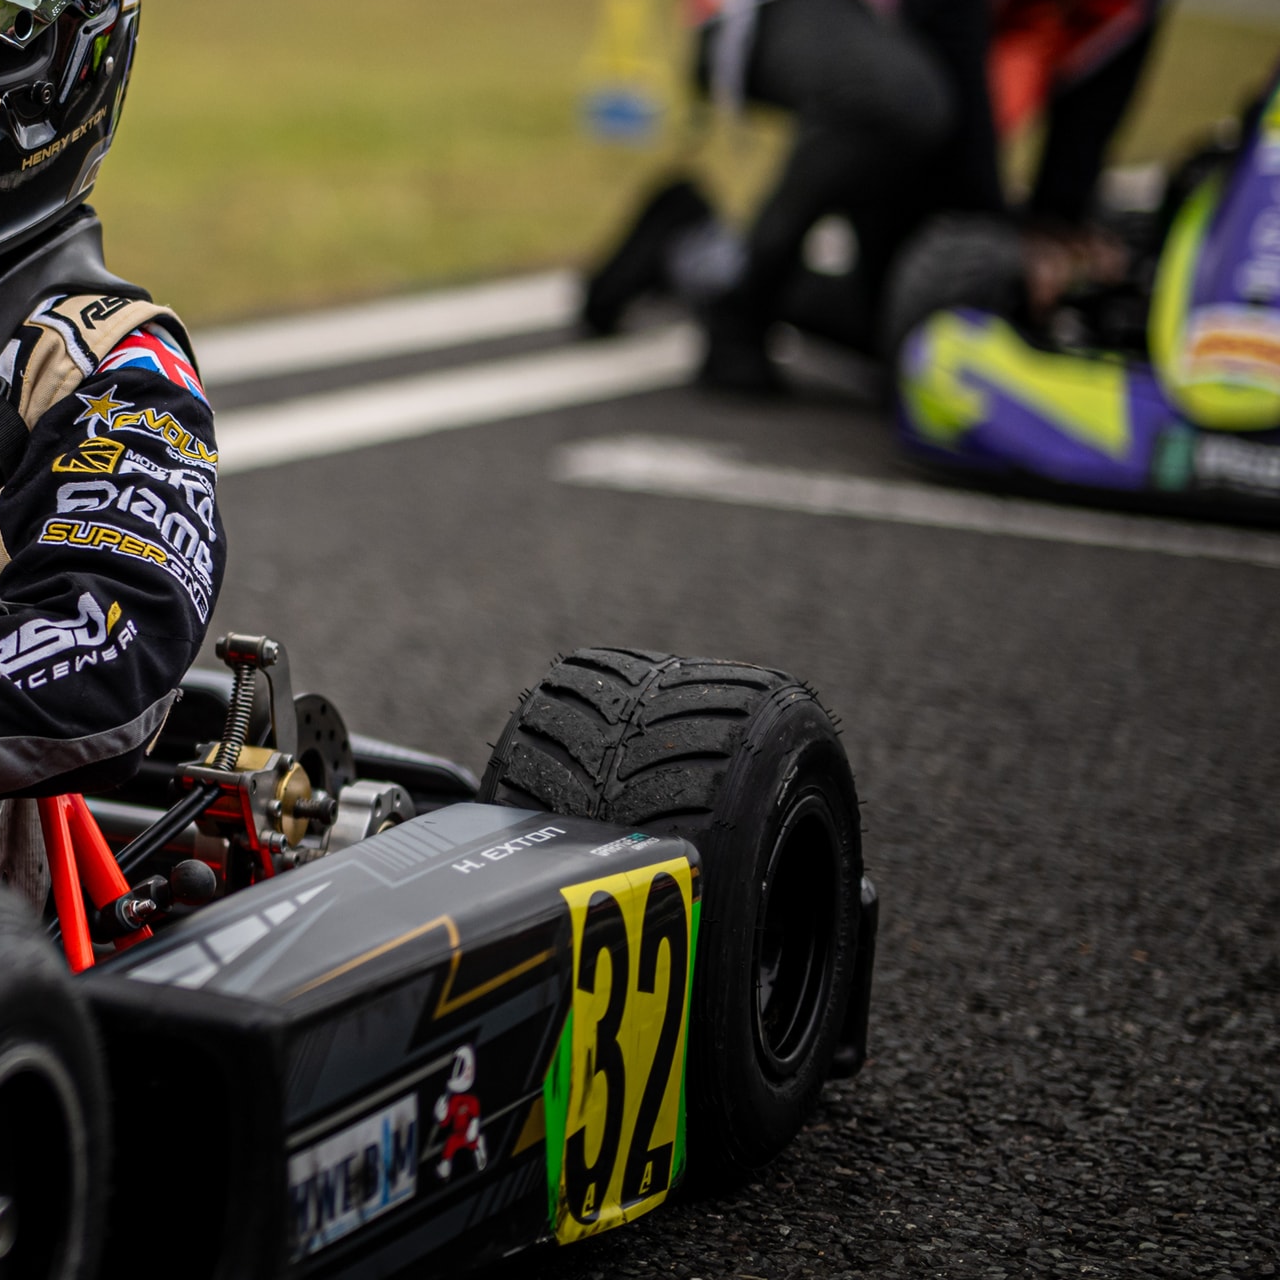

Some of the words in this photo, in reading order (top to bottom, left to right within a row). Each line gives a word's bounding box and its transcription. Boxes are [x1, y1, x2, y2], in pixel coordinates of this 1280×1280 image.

[21, 133, 70, 172] HENRY
[71, 104, 108, 144] EXTON
[450, 858, 486, 875] H.
[480, 825, 567, 861] EXTON
[564, 870, 689, 1226] 32
